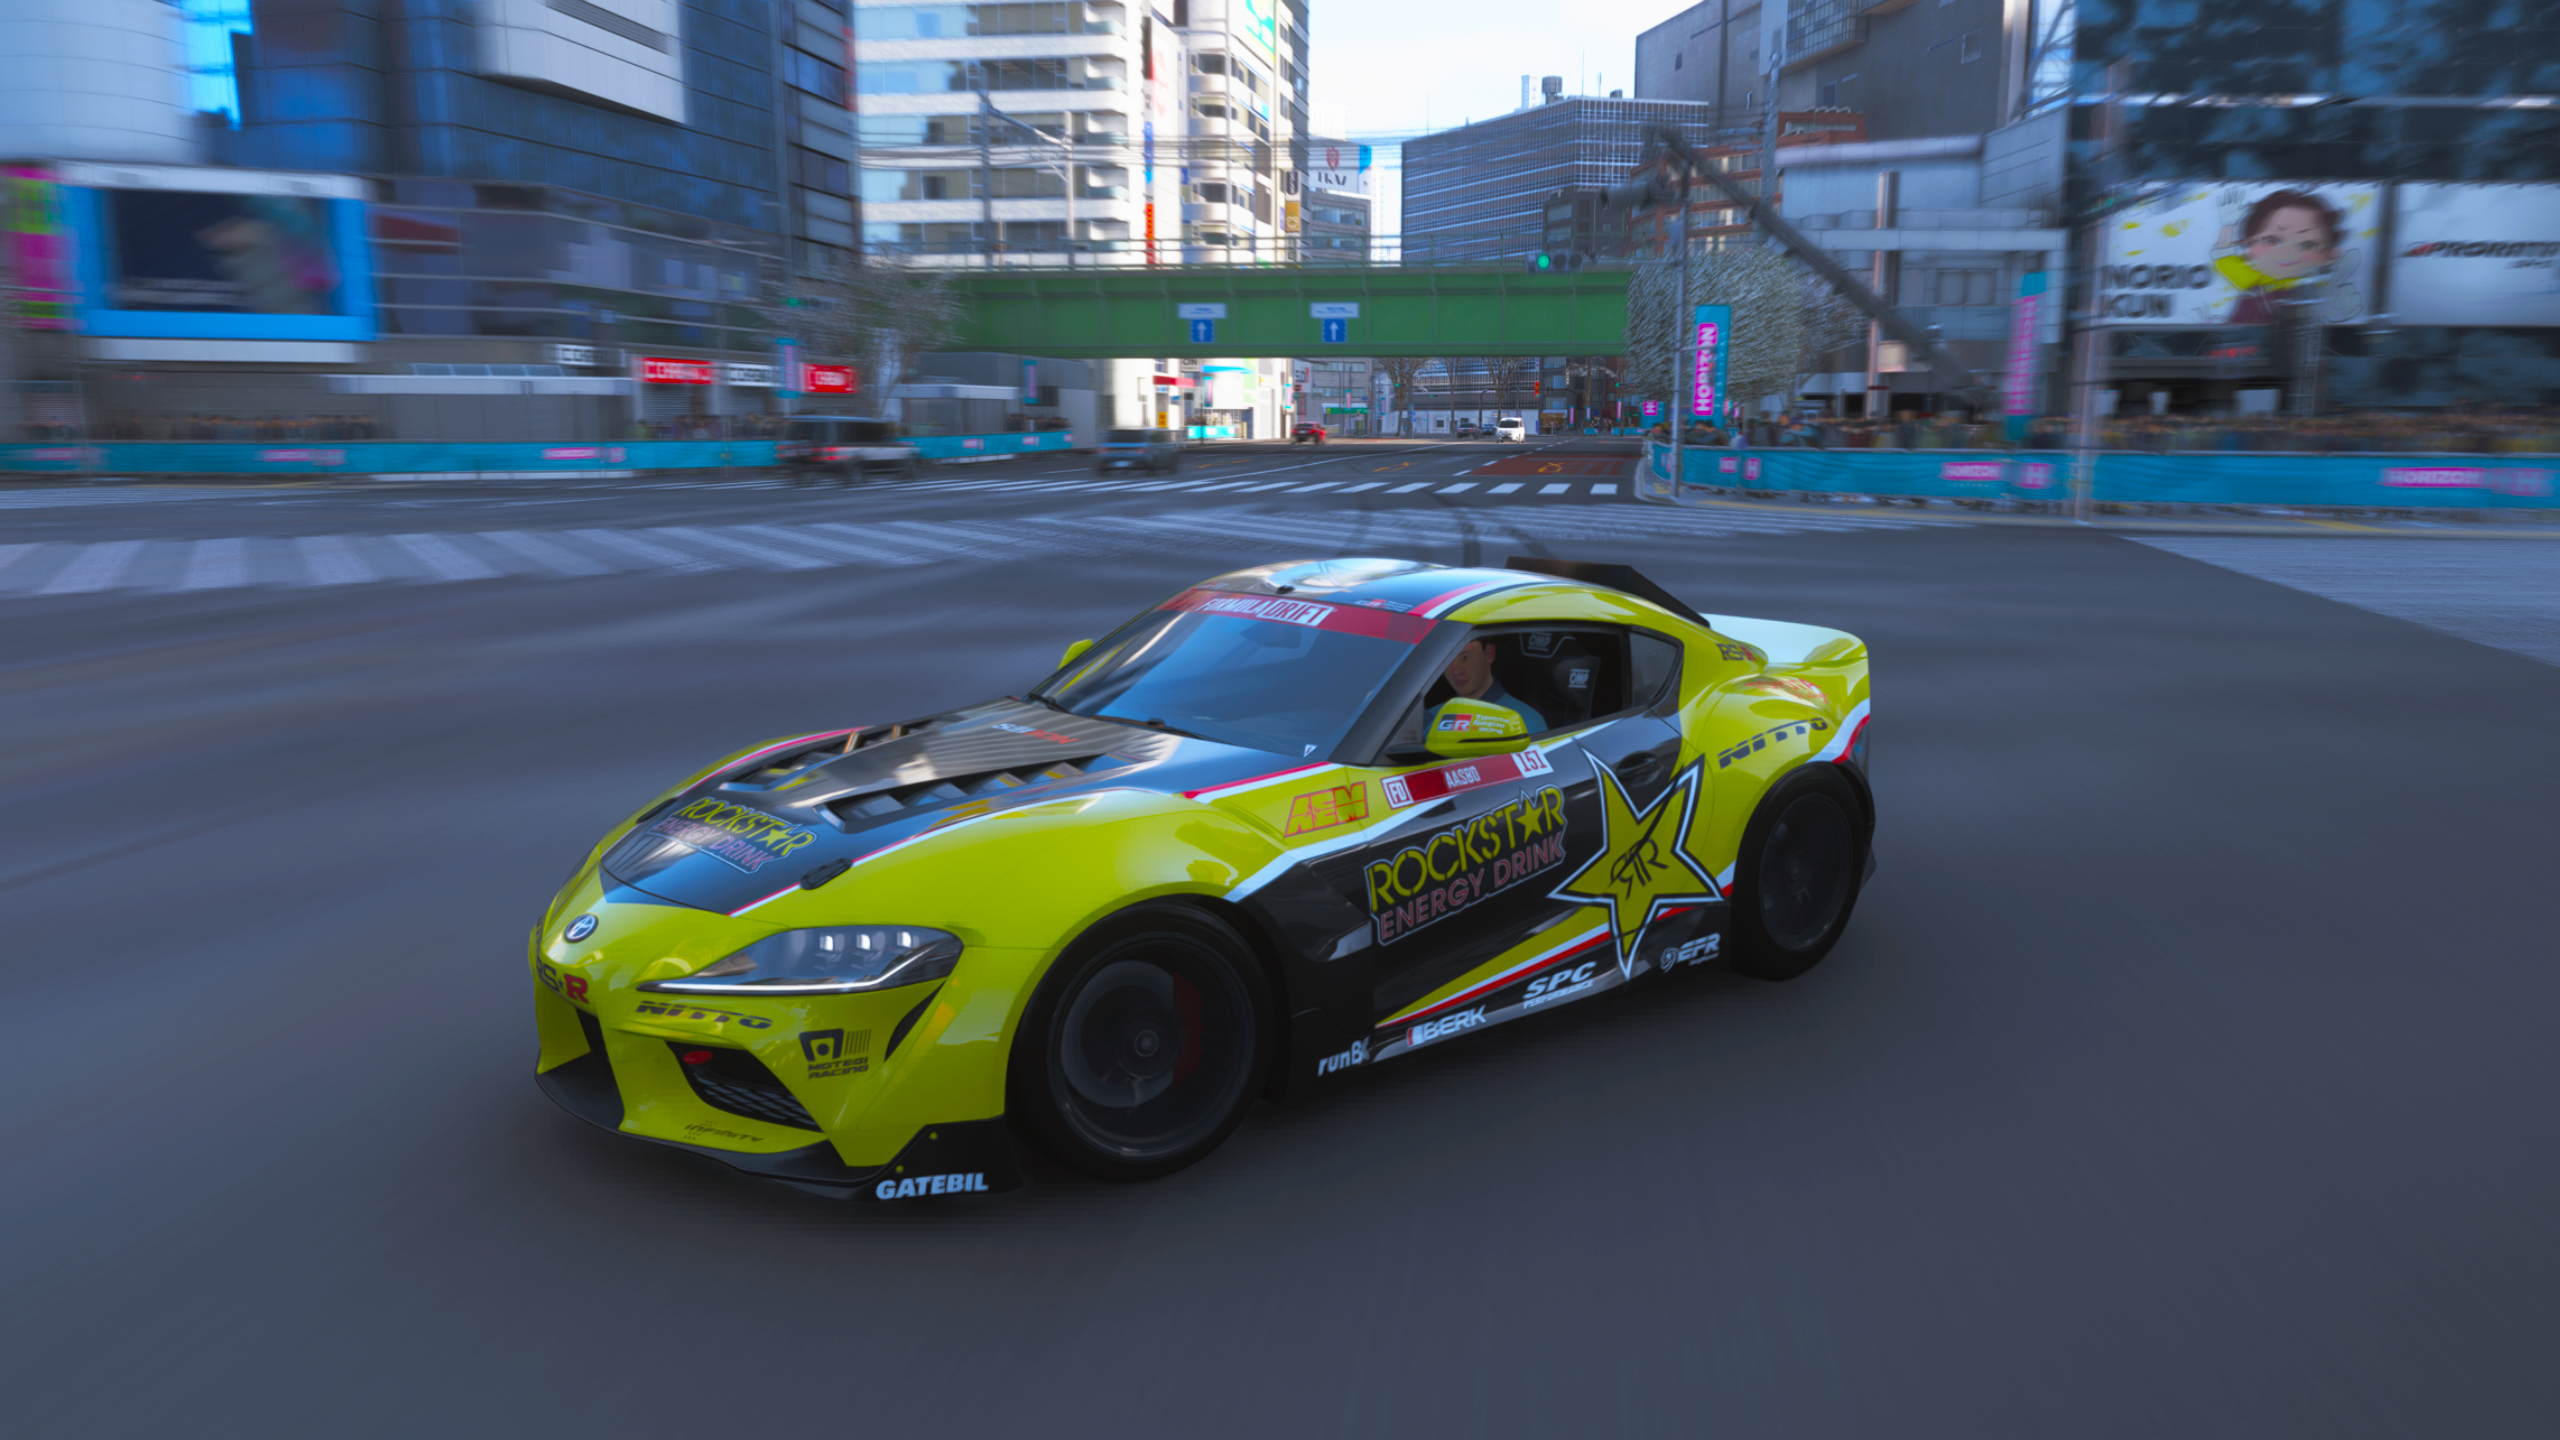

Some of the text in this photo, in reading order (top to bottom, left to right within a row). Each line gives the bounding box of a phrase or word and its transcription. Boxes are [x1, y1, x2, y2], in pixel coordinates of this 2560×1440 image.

[2101, 264, 2211, 289] NORIO
[2100, 293, 2173, 318] KUN
[2388, 470, 2481, 484] HORIZON
[1438, 719, 1471, 731] GR
[1717, 717, 1828, 770] NITTO
[1444, 765, 1481, 789] AASBO
[1516, 750, 1548, 772] 151
[1284, 781, 1370, 838] AEM
[653, 817, 774, 870] ENERGY DRINK
[1380, 832, 1562, 940] ENERGY DRINK
[1676, 933, 1720, 963] EFR
[1523, 961, 1597, 999] SPC
[635, 1000, 773, 1029] NITTO
[1422, 1005, 1487, 1041] BERK
[808, 1057, 868, 1071] MOTEGI
[809, 1064, 869, 1079] RACING
[876, 1172, 989, 1200] GATEBIL
